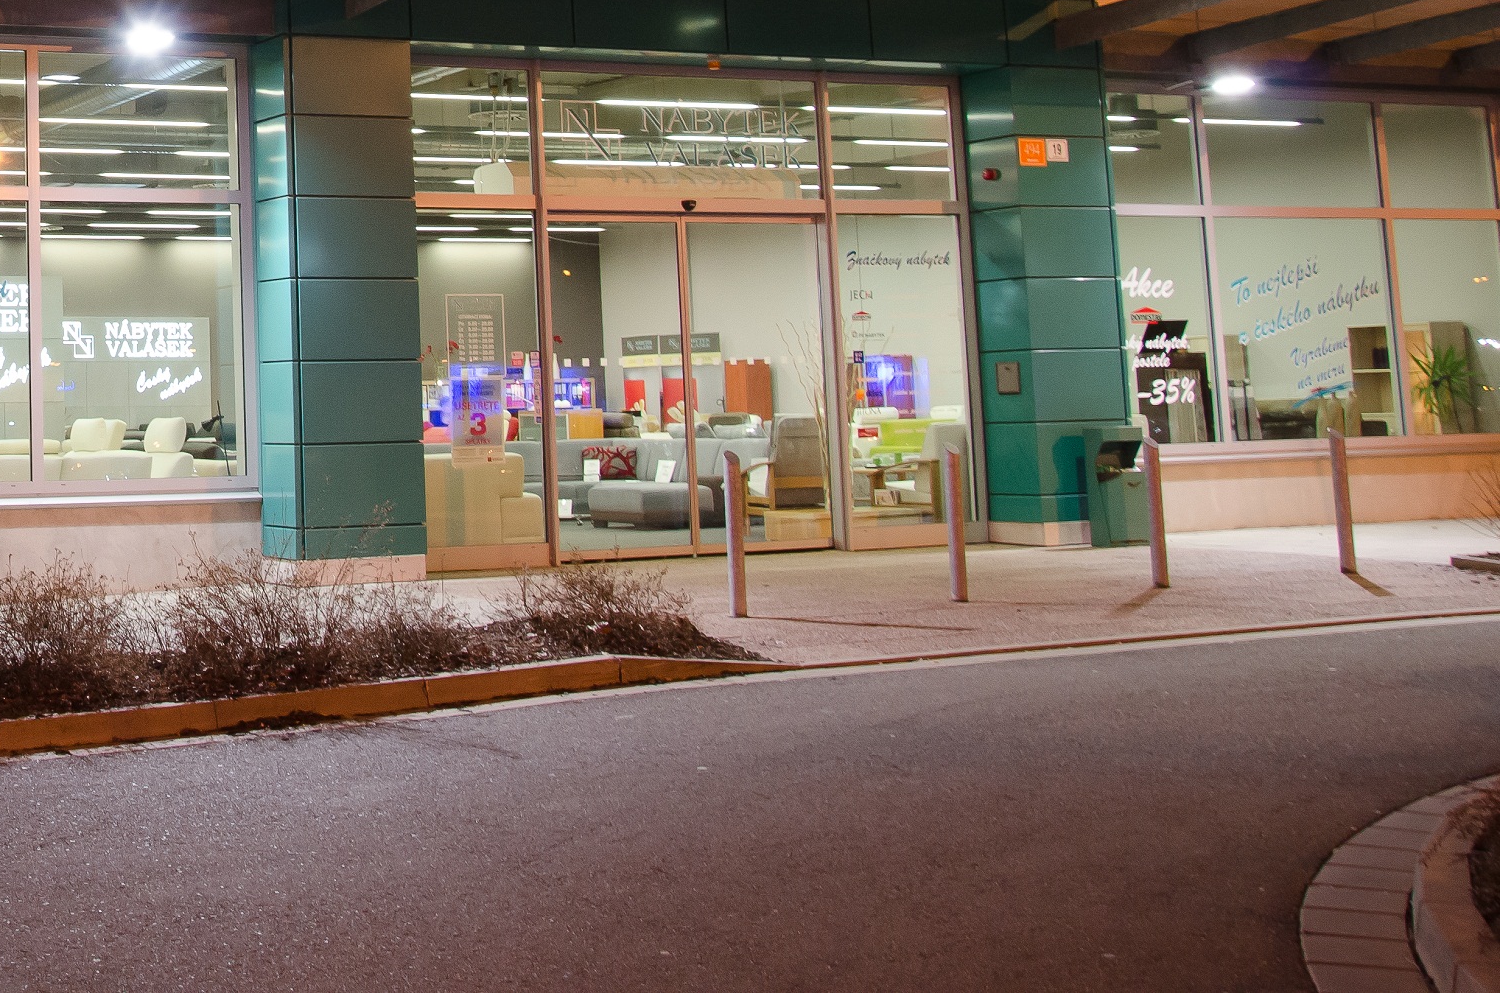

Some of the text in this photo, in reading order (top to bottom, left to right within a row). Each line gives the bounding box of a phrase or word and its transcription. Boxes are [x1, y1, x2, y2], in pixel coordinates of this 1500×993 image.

[640, 99, 801, 136] NÁBYTEK
[1052, 143, 1062, 156] 19
[847, 250, 950, 271] Značkový nábytek
[1117, 266, 1175, 299] Akce
[1230, 256, 1318, 306] To nejlepší
[1254, 300, 1311, 340] českého
[1318, 276, 1379, 312] nábytku
[105, 318, 194, 340] NÁBYTEK
[1132, 351, 1172, 371] postele
[1297, 375, 1313, 390] na
[470, 412, 487, 436] 3
